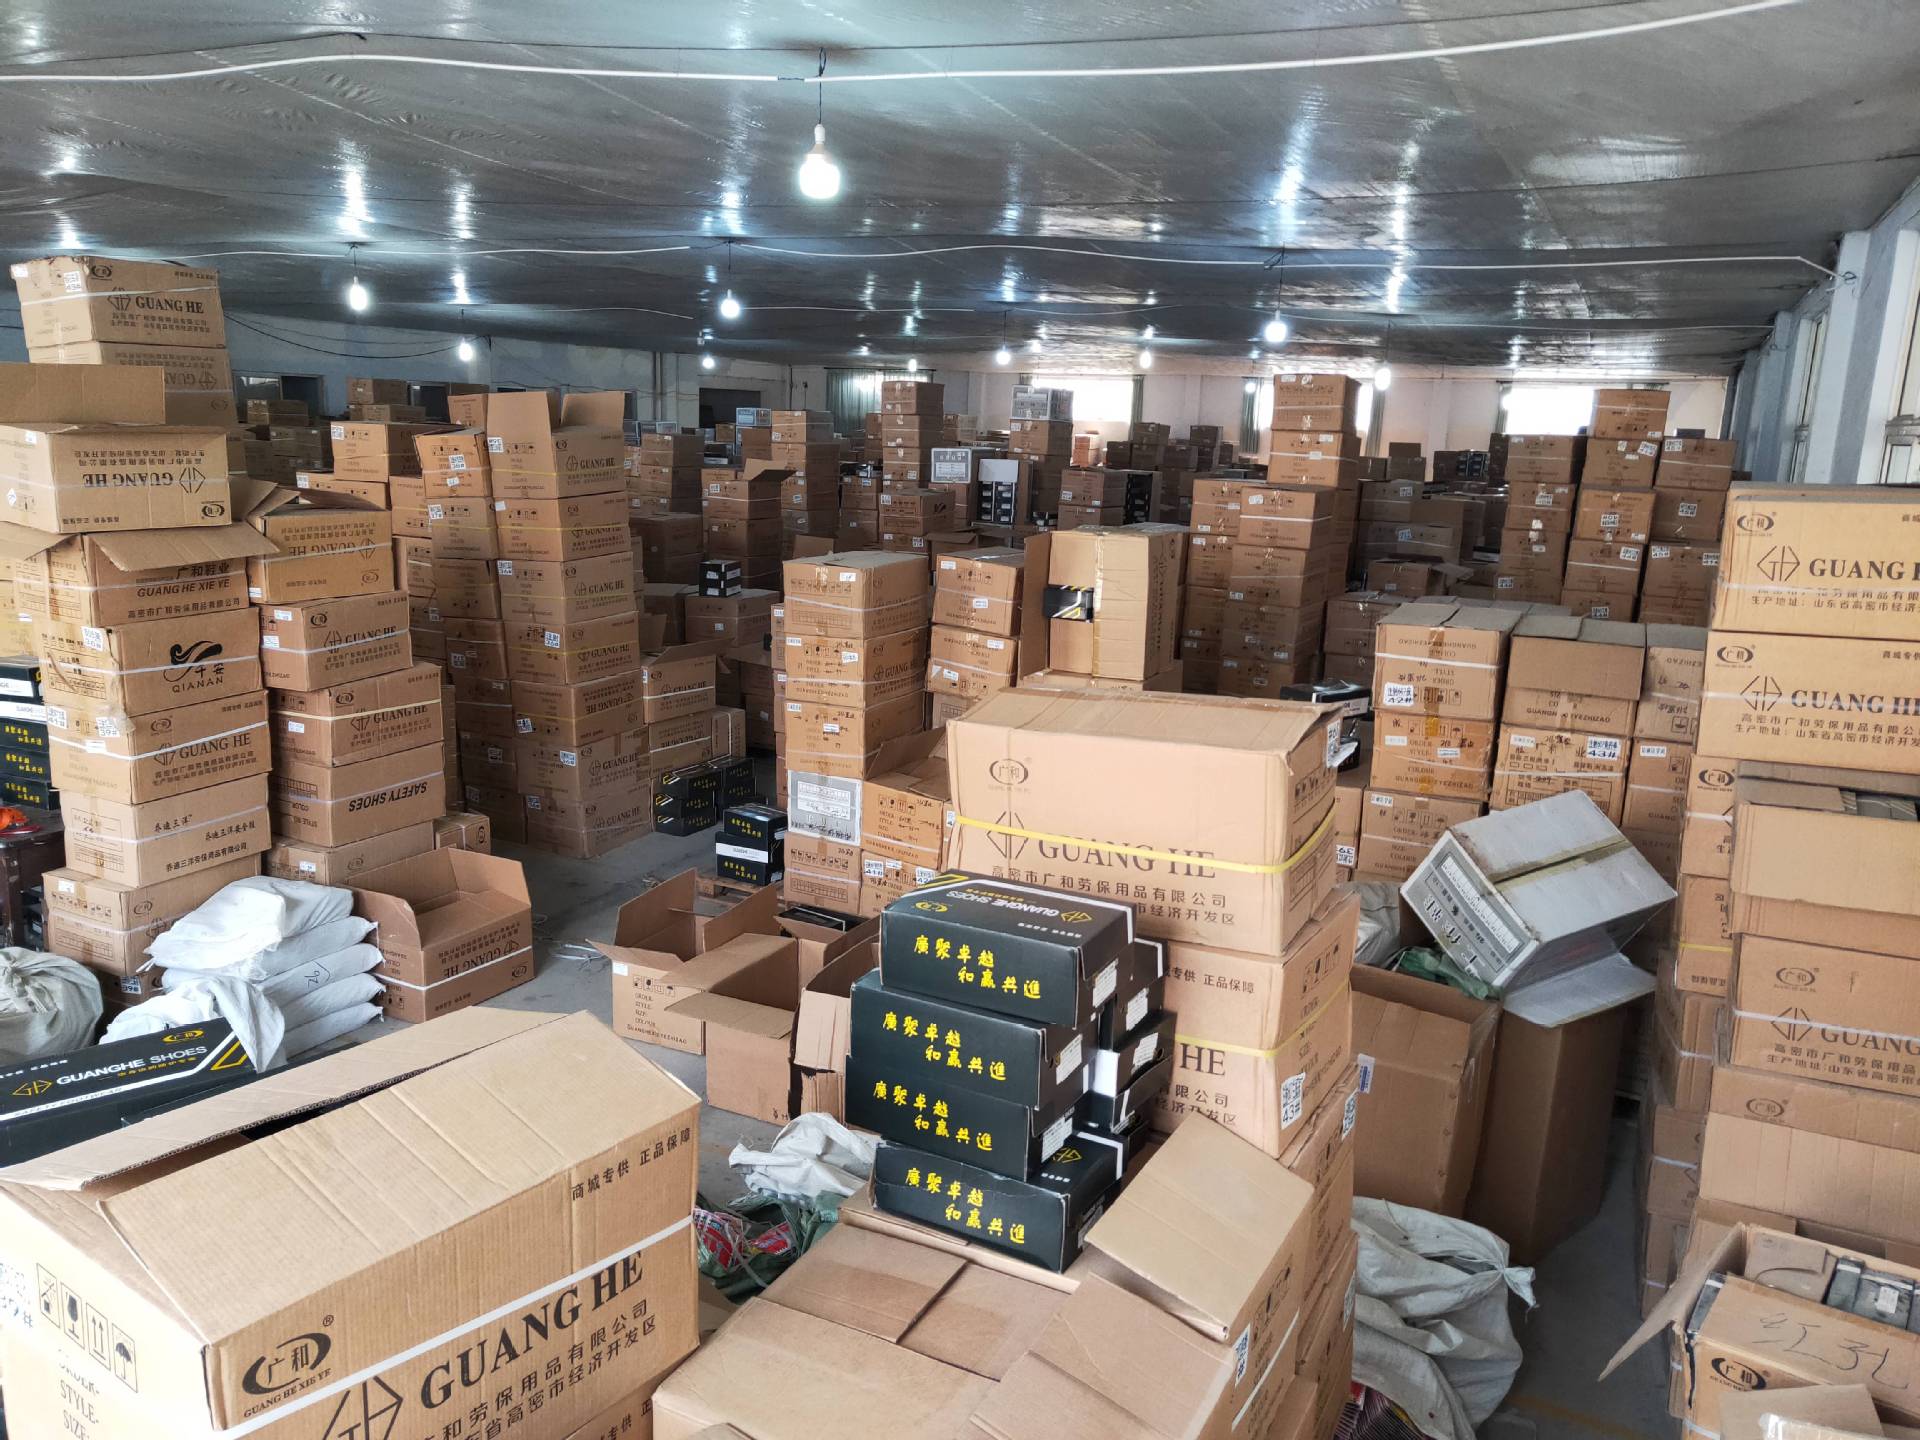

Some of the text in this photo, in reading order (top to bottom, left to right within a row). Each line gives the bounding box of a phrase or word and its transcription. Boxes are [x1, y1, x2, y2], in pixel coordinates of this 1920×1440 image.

[136, 295, 204, 313] GUANG HE
[580, 457, 615, 468] GUANG HE
[82, 472, 174, 488] GUANG HE
[1809, 558, 1904, 580] GUANG
[137, 579, 230, 598] GUANG HE XIE YE
[588, 580, 624, 594] GUANG HE
[172, 676, 223, 694] QIANAN
[1791, 689, 1884, 714] GUANG
[373, 707, 411, 724] GUANG
[1741, 713, 1920, 735] 高密市广和劳保用品有限公
[180, 733, 251, 759] GUANG HE
[603, 756, 628, 770] GUANG
[348, 781, 427, 812] SAFETY SHOES
[1039, 834, 1216, 879] GUANG HE
[991, 864, 1227, 908] 高密市广和劳保用品有限公司
[946, 890, 990, 905] SHOES
[991, 897, 1060, 917] GUANGHE
[443, 947, 501, 978] GUANG HE
[1202, 973, 1255, 994] 正品保障
[56, 1058, 146, 1085] GUANGHE
[150, 1046, 208, 1063] SHOES
[1180, 1042, 1226, 1077] HE
[571, 1128, 692, 1201] 商城专供 正品保障
[421, 1251, 643, 1410] GUANG HE
[423, 1299, 648, 1440] 和劳保用品有限公司
[243, 1367, 332, 1419] GUANG HE XIE YE
